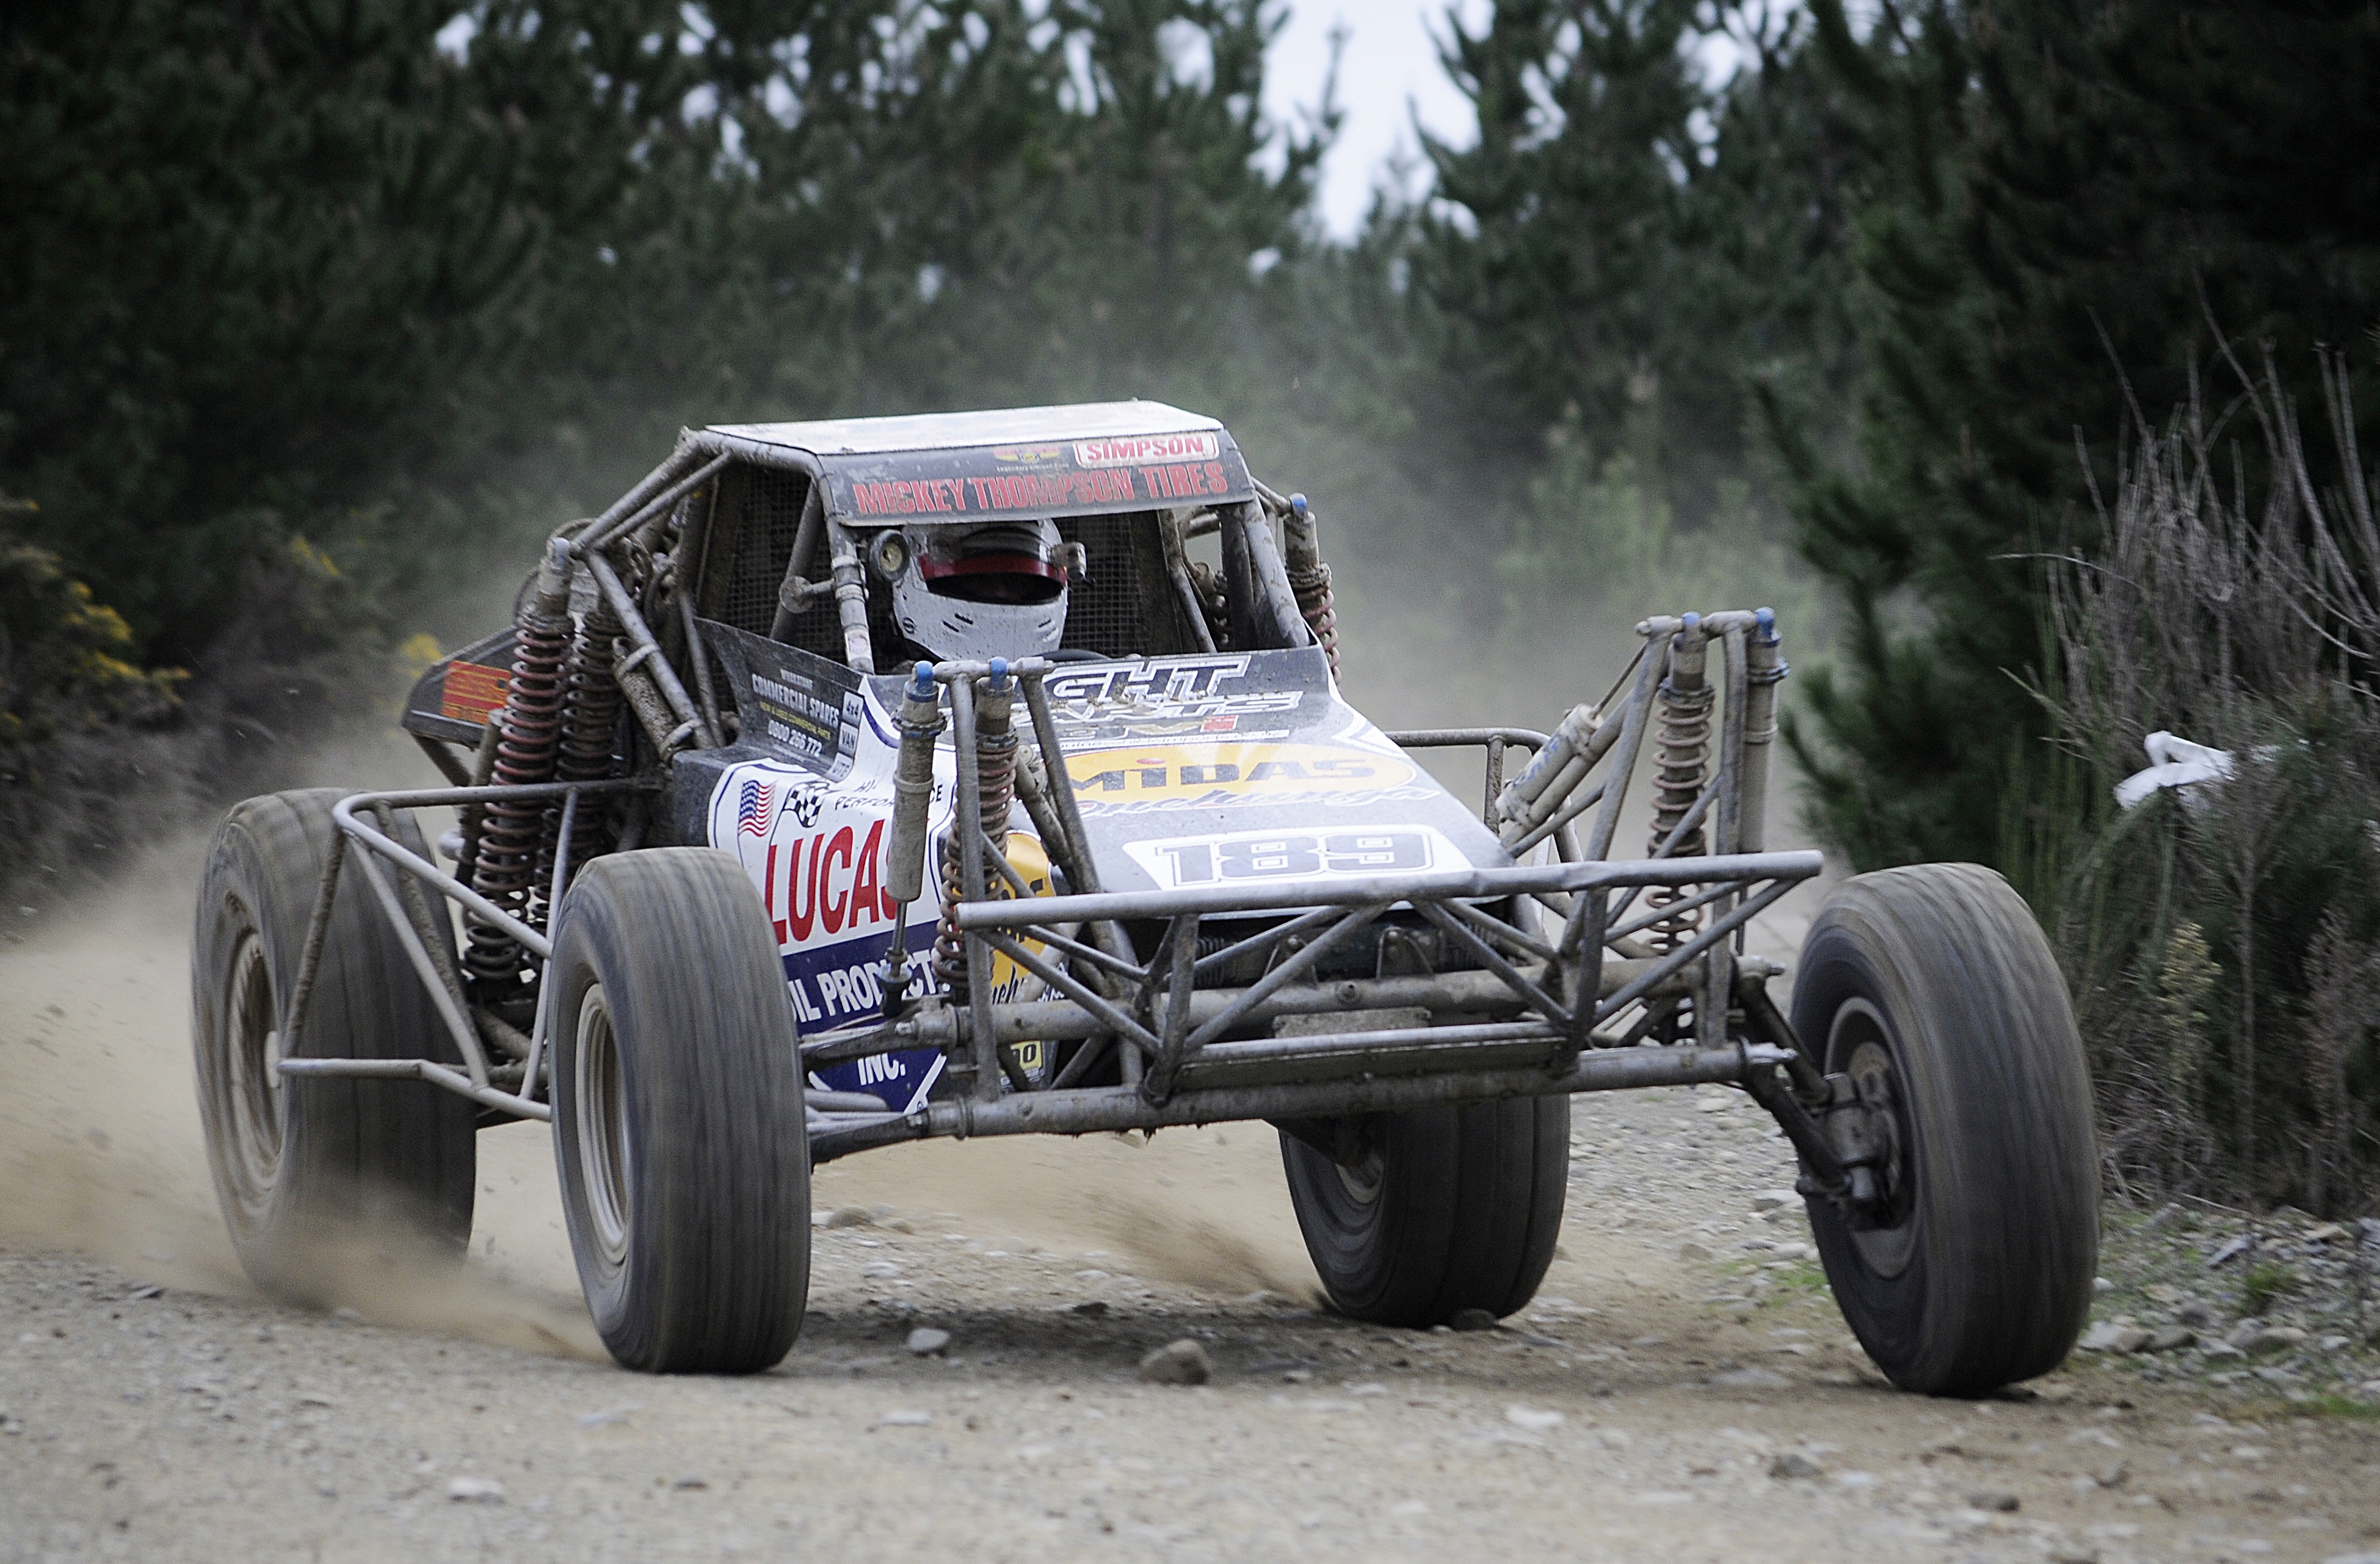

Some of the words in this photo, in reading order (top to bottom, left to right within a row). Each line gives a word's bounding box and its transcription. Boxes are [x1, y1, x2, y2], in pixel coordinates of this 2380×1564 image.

[1086, 436, 1203, 461] SIMPSON
[852, 478, 966, 514] MICKEY
[968, 468, 1135, 510] THOMPSON
[1139, 462, 1228, 498] TIRES
[752, 673, 808, 715] COMMERCIAL
[810, 697, 840, 729] SPARES
[805, 736, 822, 757] 772
[841, 729, 856, 749] VAN
[1155, 832, 1434, 887] 189
[787, 978, 822, 1023] IL
